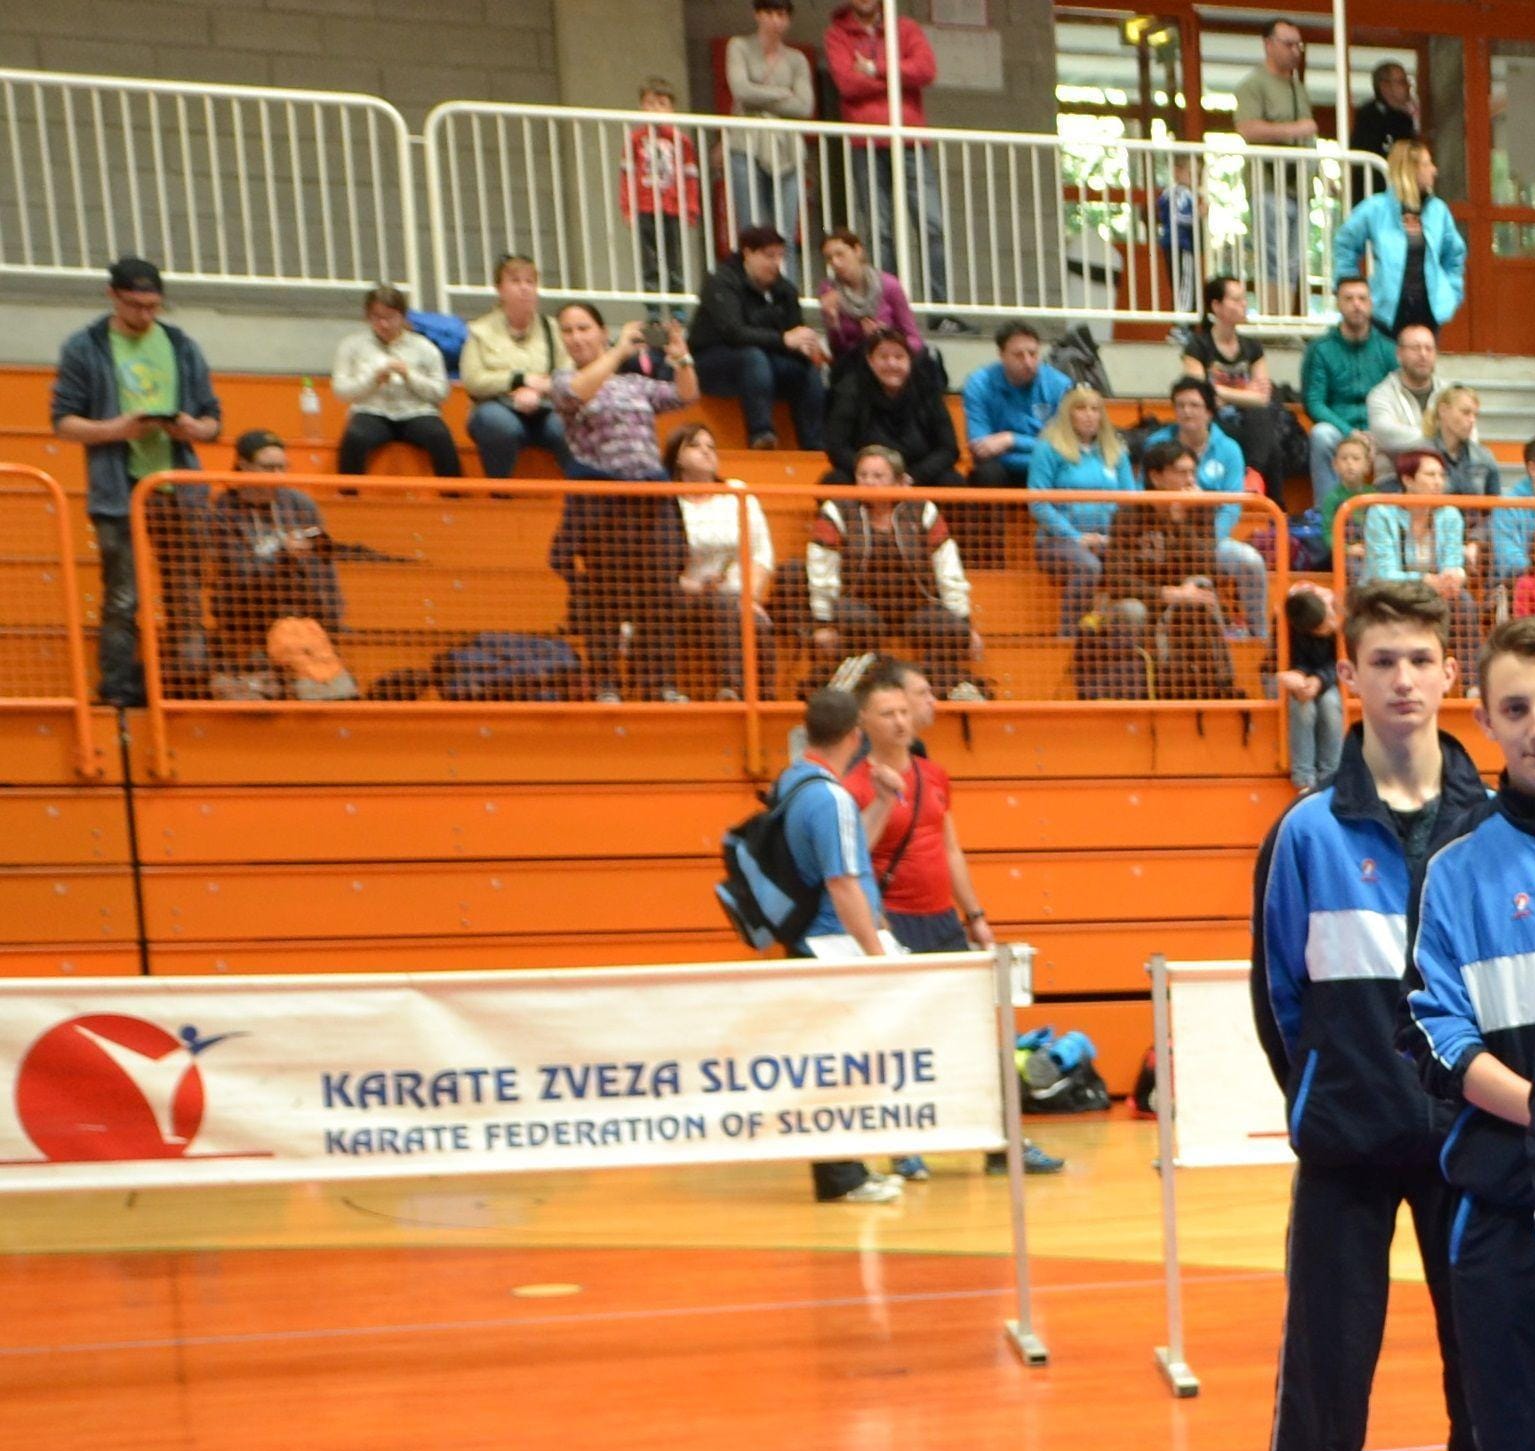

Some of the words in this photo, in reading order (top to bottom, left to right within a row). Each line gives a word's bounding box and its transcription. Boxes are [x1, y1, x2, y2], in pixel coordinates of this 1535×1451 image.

[322, 1067, 519, 1109] KARATE
[538, 1062, 680, 1098] ZVEZA
[700, 1048, 936, 1092] SLOVENIJE
[325, 1124, 470, 1155] KARATE
[485, 1115, 706, 1149] FEDERATION
[721, 1111, 763, 1138] OF
[779, 1102, 937, 1134] SLOVENIA
